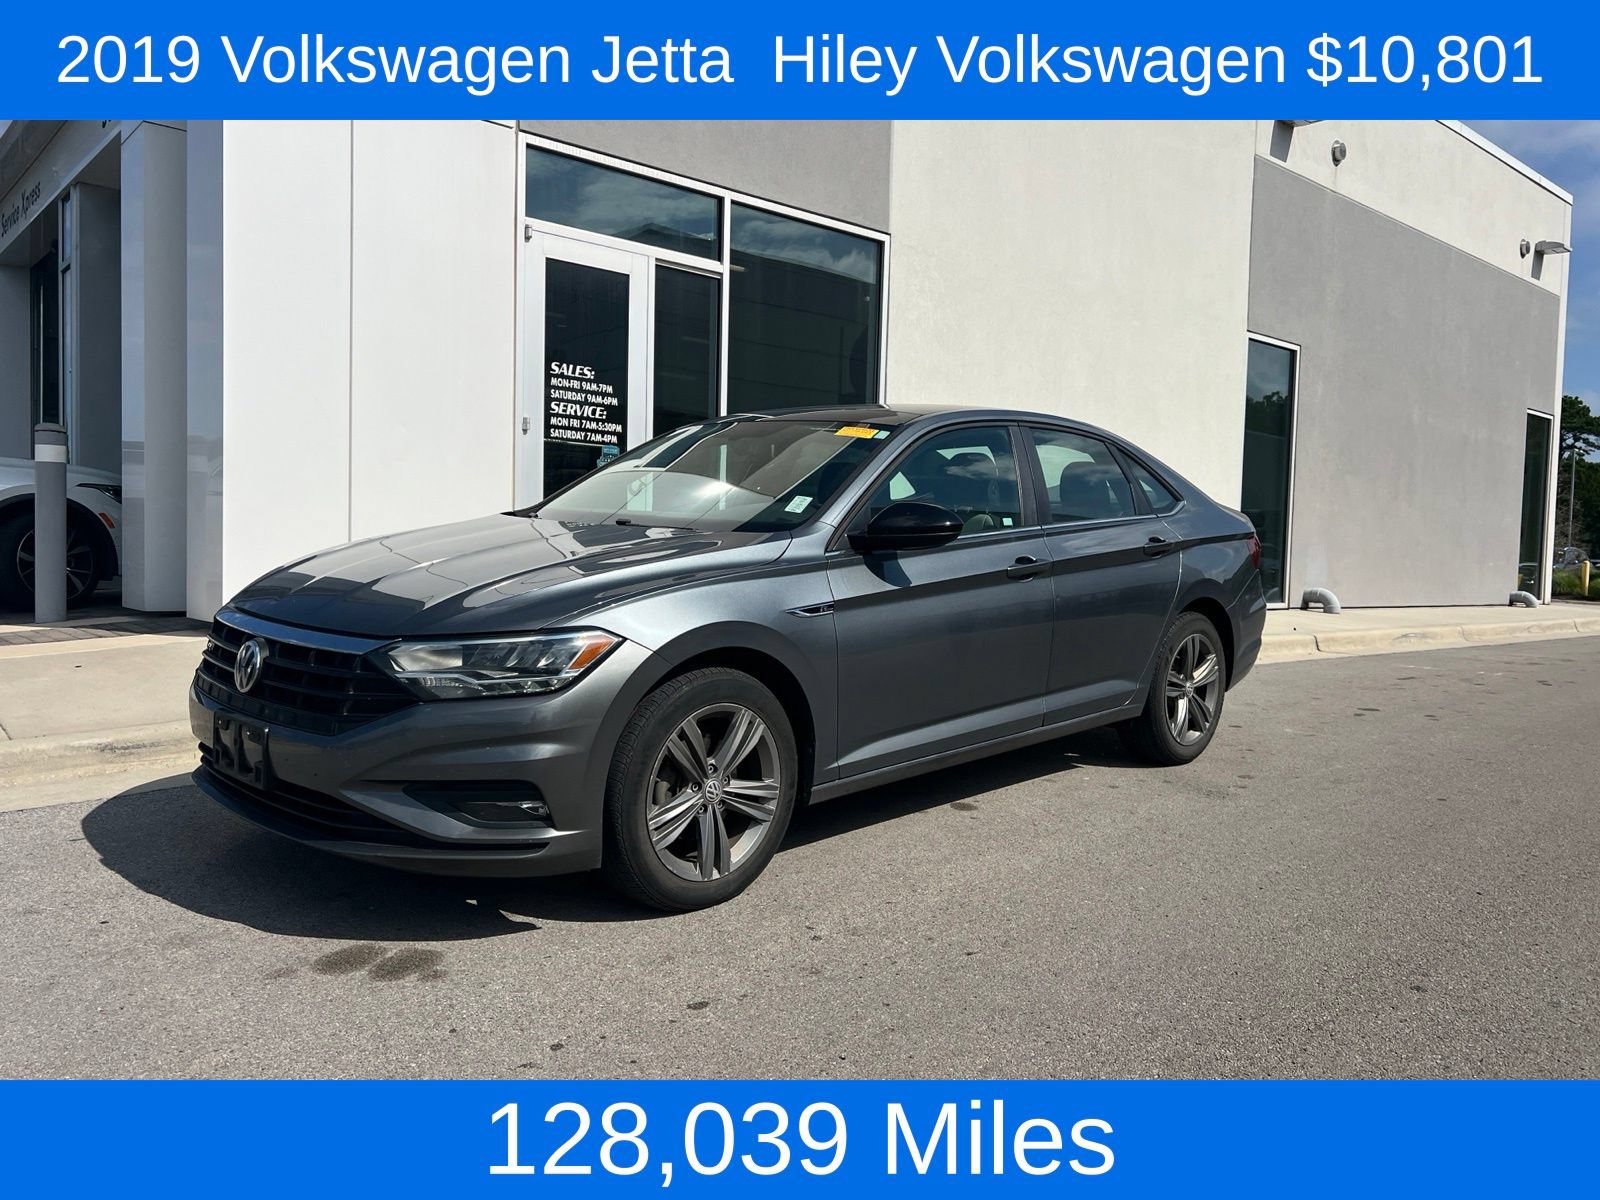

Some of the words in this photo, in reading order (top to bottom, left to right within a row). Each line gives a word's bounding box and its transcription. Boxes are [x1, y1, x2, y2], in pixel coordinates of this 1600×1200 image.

[1, 203, 20, 237] Service
[21, 181, 41, 219] Xpress
[550, 361, 595, 379] SALES:
[550, 377, 580, 390] MON-FRI
[581, 381, 613, 394] 9AM-7PM
[550, 389, 586, 402] SATURDAY
[587, 394, 618, 406] 9AM-6PM
[550, 401, 607, 419] SERVICE:
[550, 416, 569, 427] MON
[570, 418, 580, 428] FRI
[581, 420, 622, 432] 7AM-5:30PM
[550, 428, 586, 440] SATURDAY
[587, 432, 618, 444] 7AM-4PM
